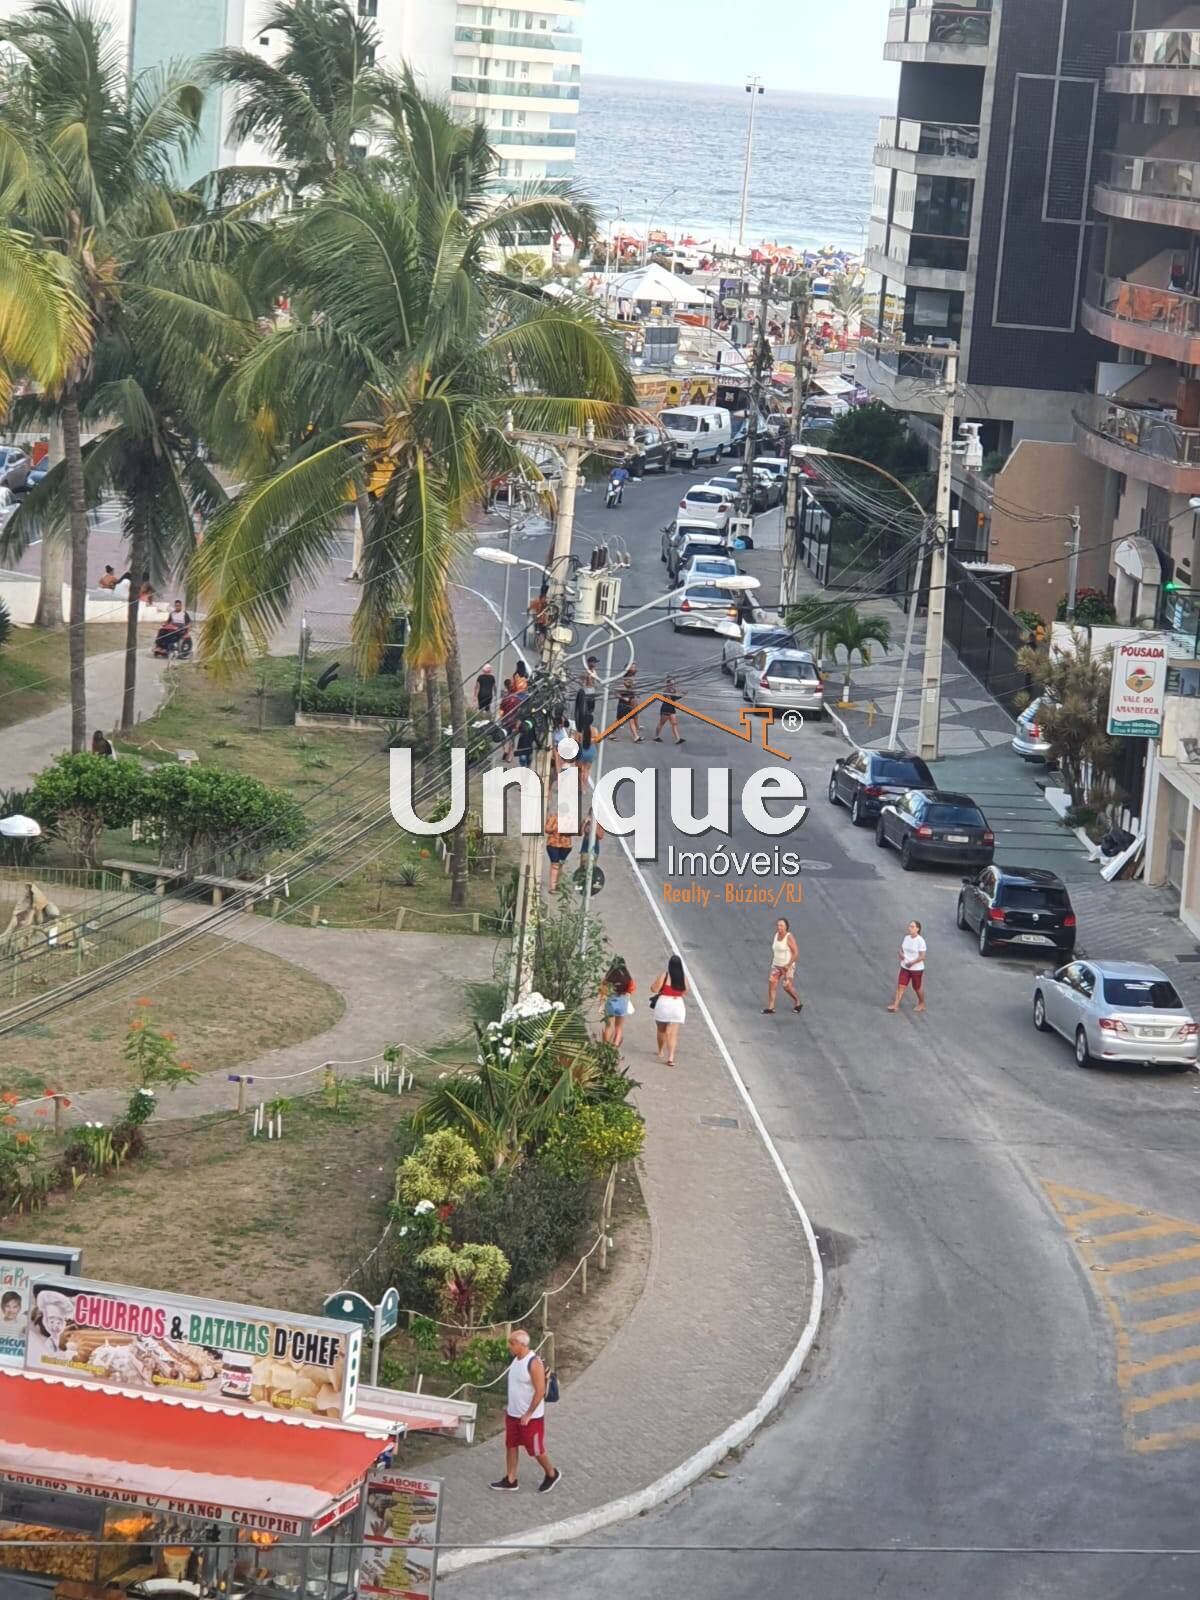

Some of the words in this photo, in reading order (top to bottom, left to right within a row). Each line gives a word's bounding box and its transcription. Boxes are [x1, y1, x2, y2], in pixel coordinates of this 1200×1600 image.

[1120, 645, 1165, 658] POUSADA
[1122, 695, 1140, 704] VALE
[1143, 695, 1155, 704] DO
[75, 1294, 166, 1340] CHURROS
[188, 1313, 270, 1357] BATATAS
[274, 1327, 341, 1368] D'CHEF
[382, 1475, 429, 1491] SABORES
[231, 1510, 298, 1534] CATUPIRI
